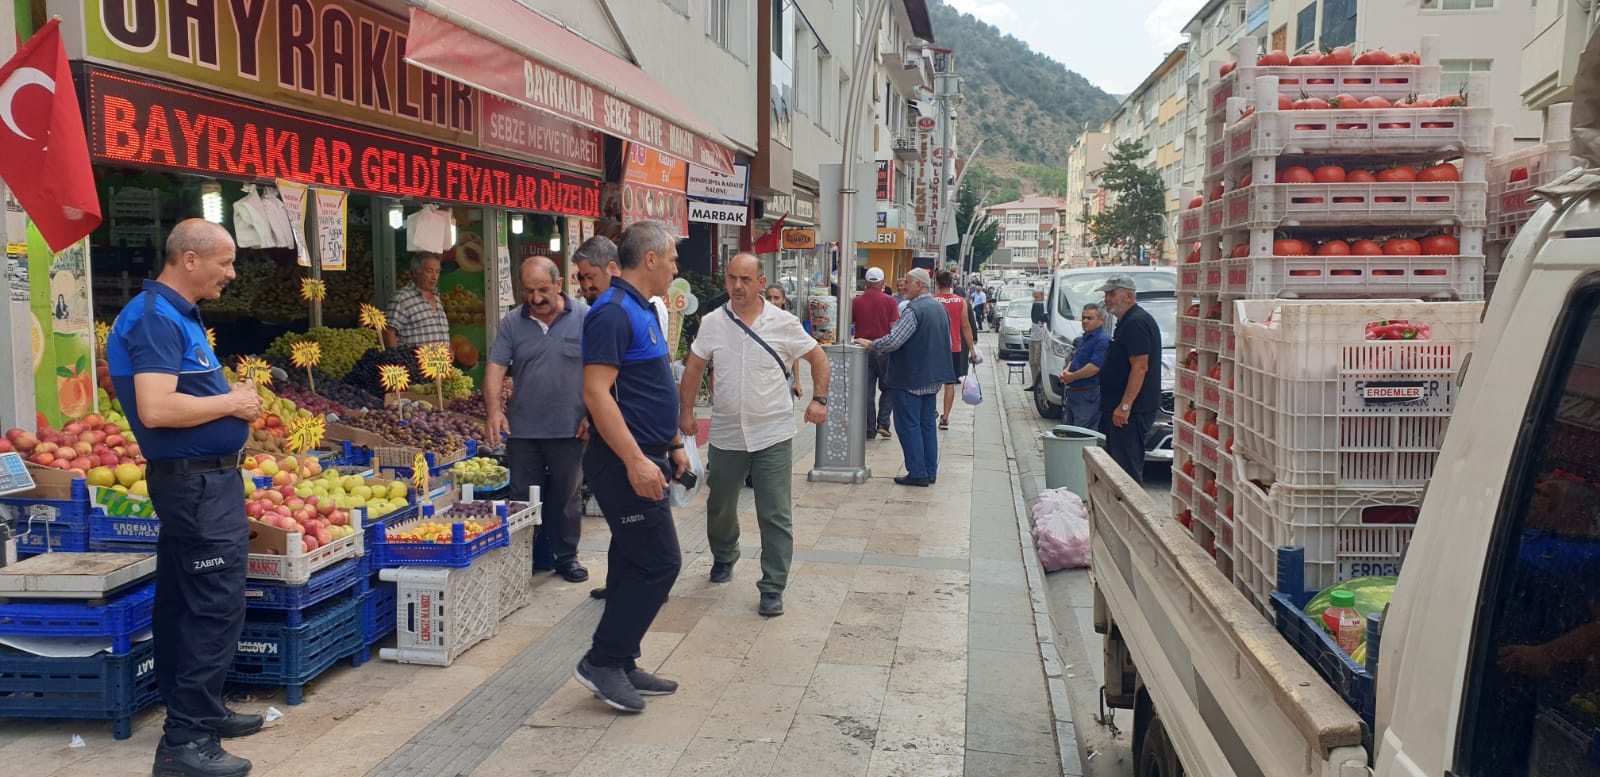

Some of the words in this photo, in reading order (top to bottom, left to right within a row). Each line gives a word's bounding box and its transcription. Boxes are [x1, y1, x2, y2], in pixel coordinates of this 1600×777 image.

[524, 60, 594, 122] BAYRAKLAR
[603, 94, 632, 135] SEBZE
[638, 109, 662, 147] MEYVE
[490, 111, 525, 145] SEBZE
[528, 122, 560, 153] MEYVE
[561, 128, 598, 164] TİCARETİ
[103, 95, 356, 190] BAYRAKLAR
[361, 146, 442, 199] GELDİ
[446, 152, 537, 211] FİYATLAR
[540, 172, 600, 218] DÜZELDİ
[692, 209, 744, 222] MARBAK
[1367, 388, 1420, 397] ERDEMLER
[621, 514, 646, 524] ZABITA
[113, 523, 160, 532] ERDEMLE
[193, 557, 225, 570] ZABITA
